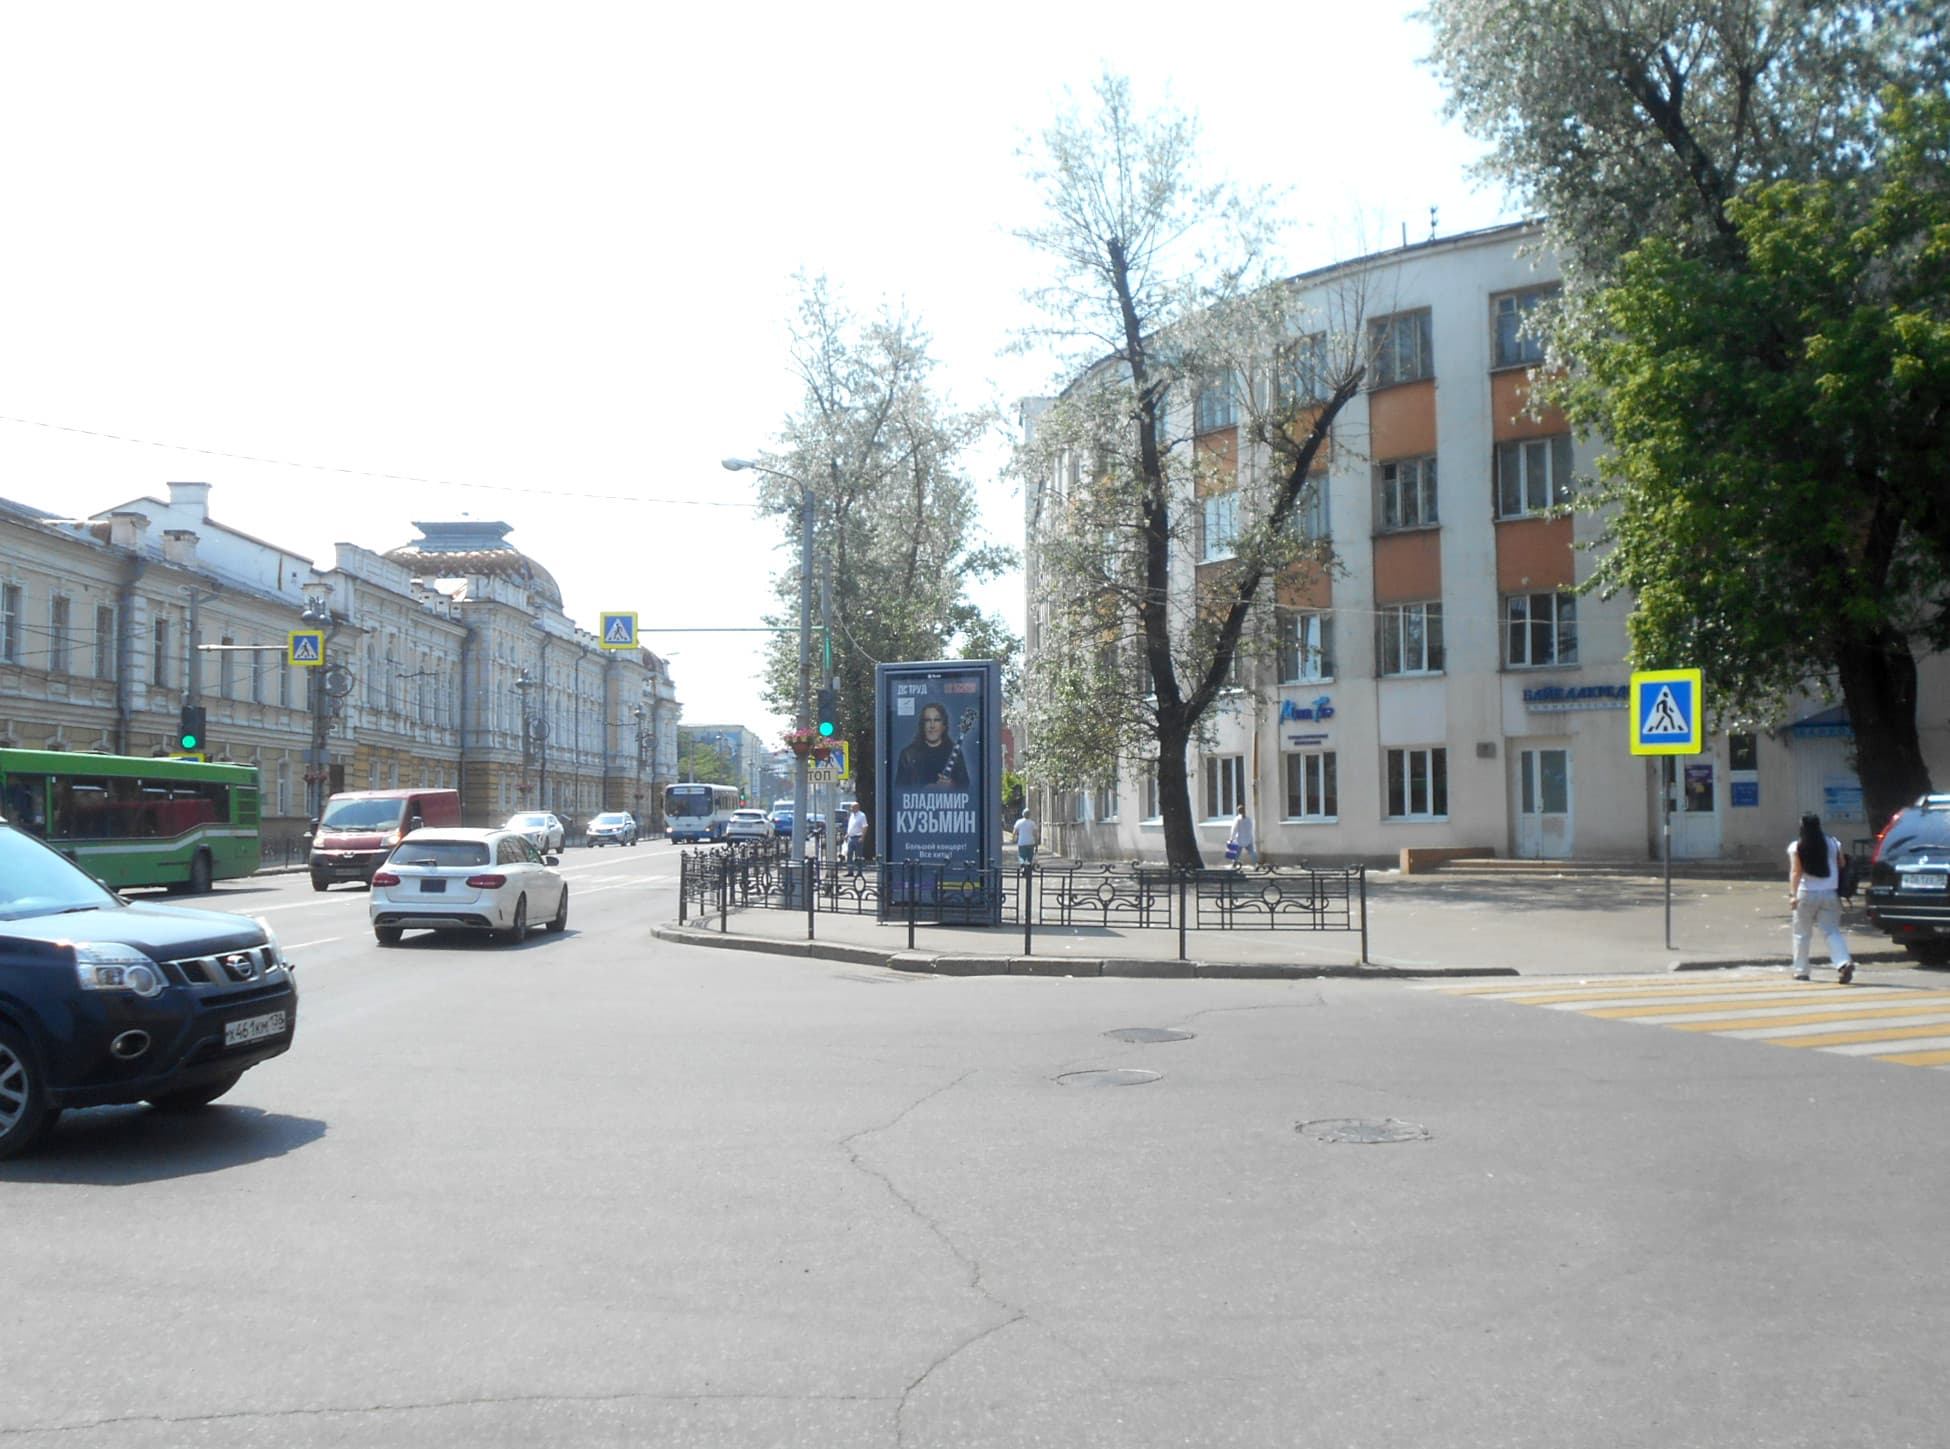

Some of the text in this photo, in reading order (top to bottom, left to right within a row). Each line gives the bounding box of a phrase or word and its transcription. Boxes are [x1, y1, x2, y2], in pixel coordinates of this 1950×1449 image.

[909, 684, 928, 695] ТРУД
[1523, 685, 1631, 701] БАЙКАЛКРЕД
[808, 770, 831, 781] ТОП
[903, 793, 969, 811] ВЛАДИМИР
[896, 811, 976, 833] КУЗЬМИН
